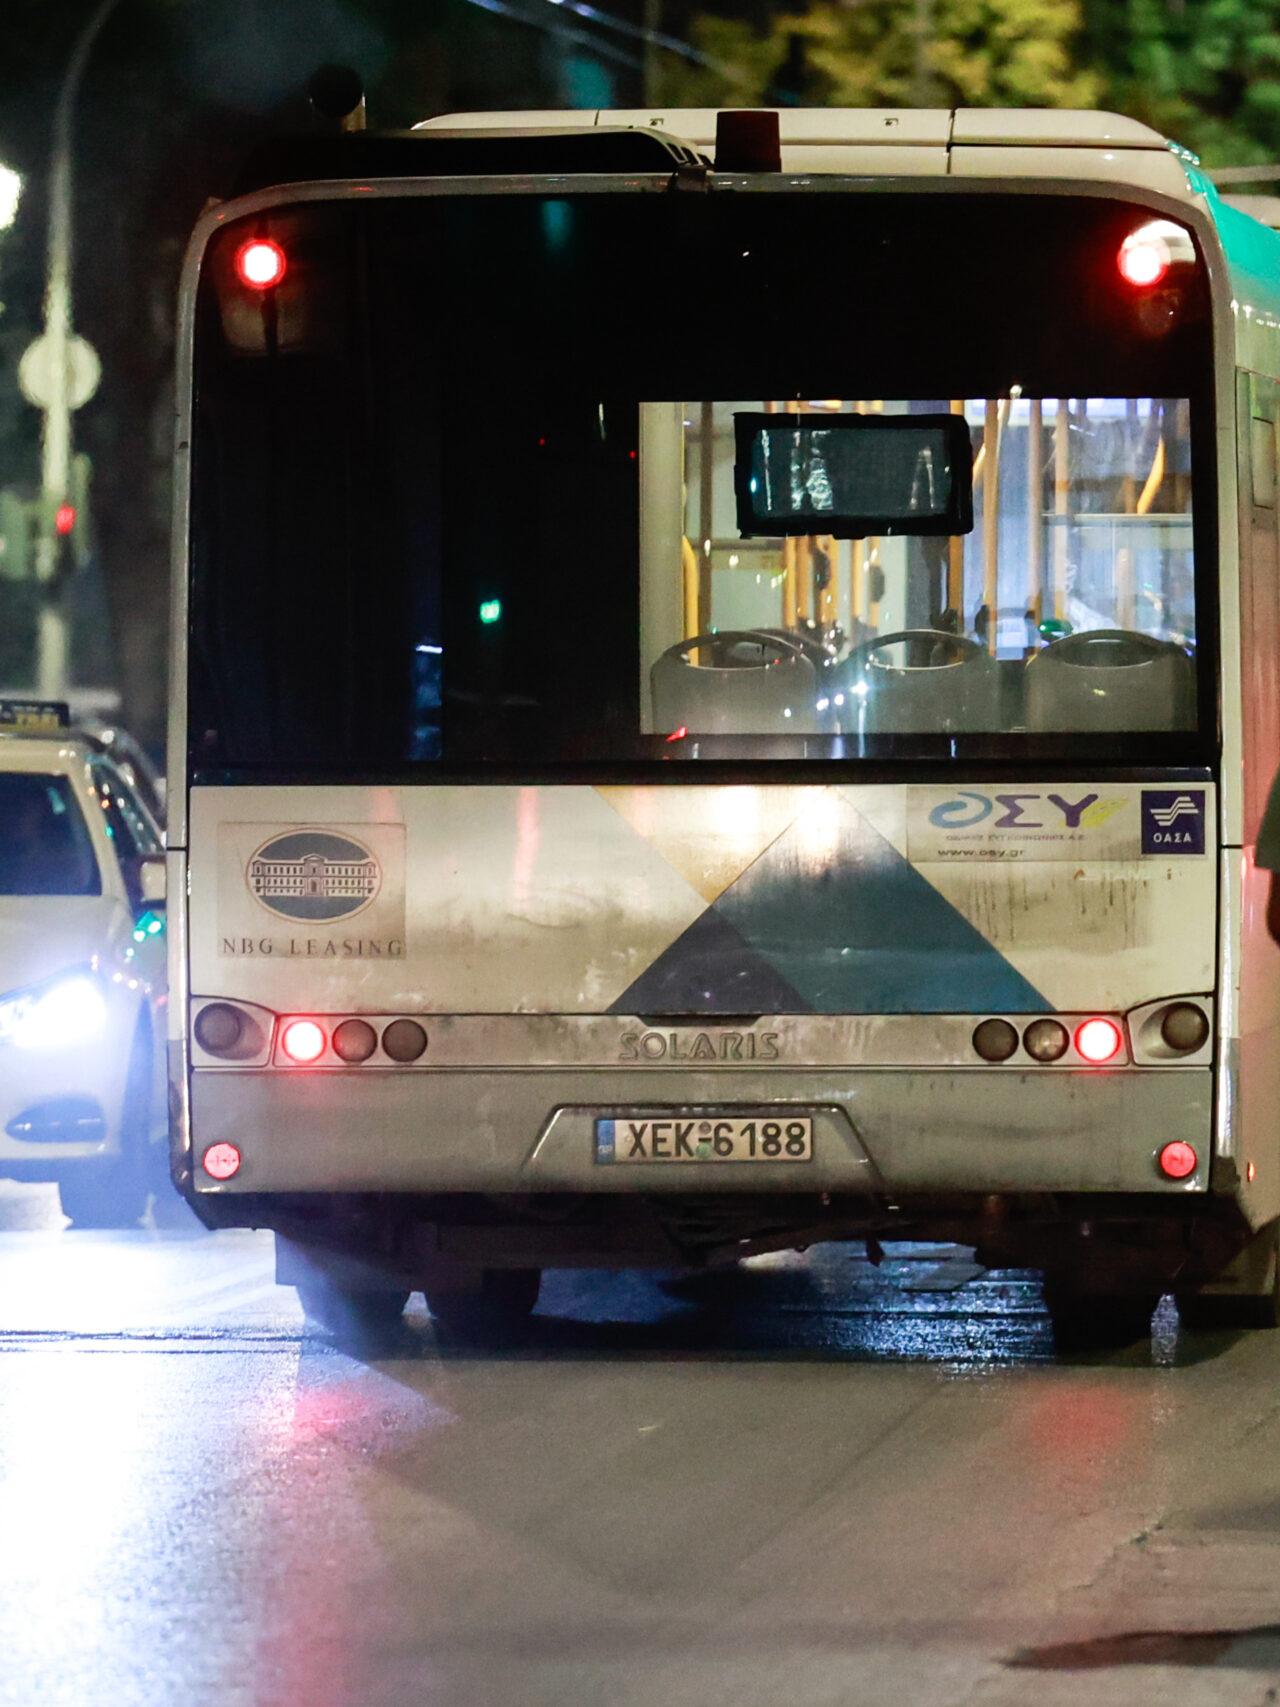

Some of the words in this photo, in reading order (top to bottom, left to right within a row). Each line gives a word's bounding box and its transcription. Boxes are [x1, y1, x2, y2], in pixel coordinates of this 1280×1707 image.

[937, 848, 1025, 858] www.osy.gr
[223, 937, 273, 955] NBG
[290, 938, 402, 956] LEASING
[618, 1032, 780, 1060] SOLARIS
